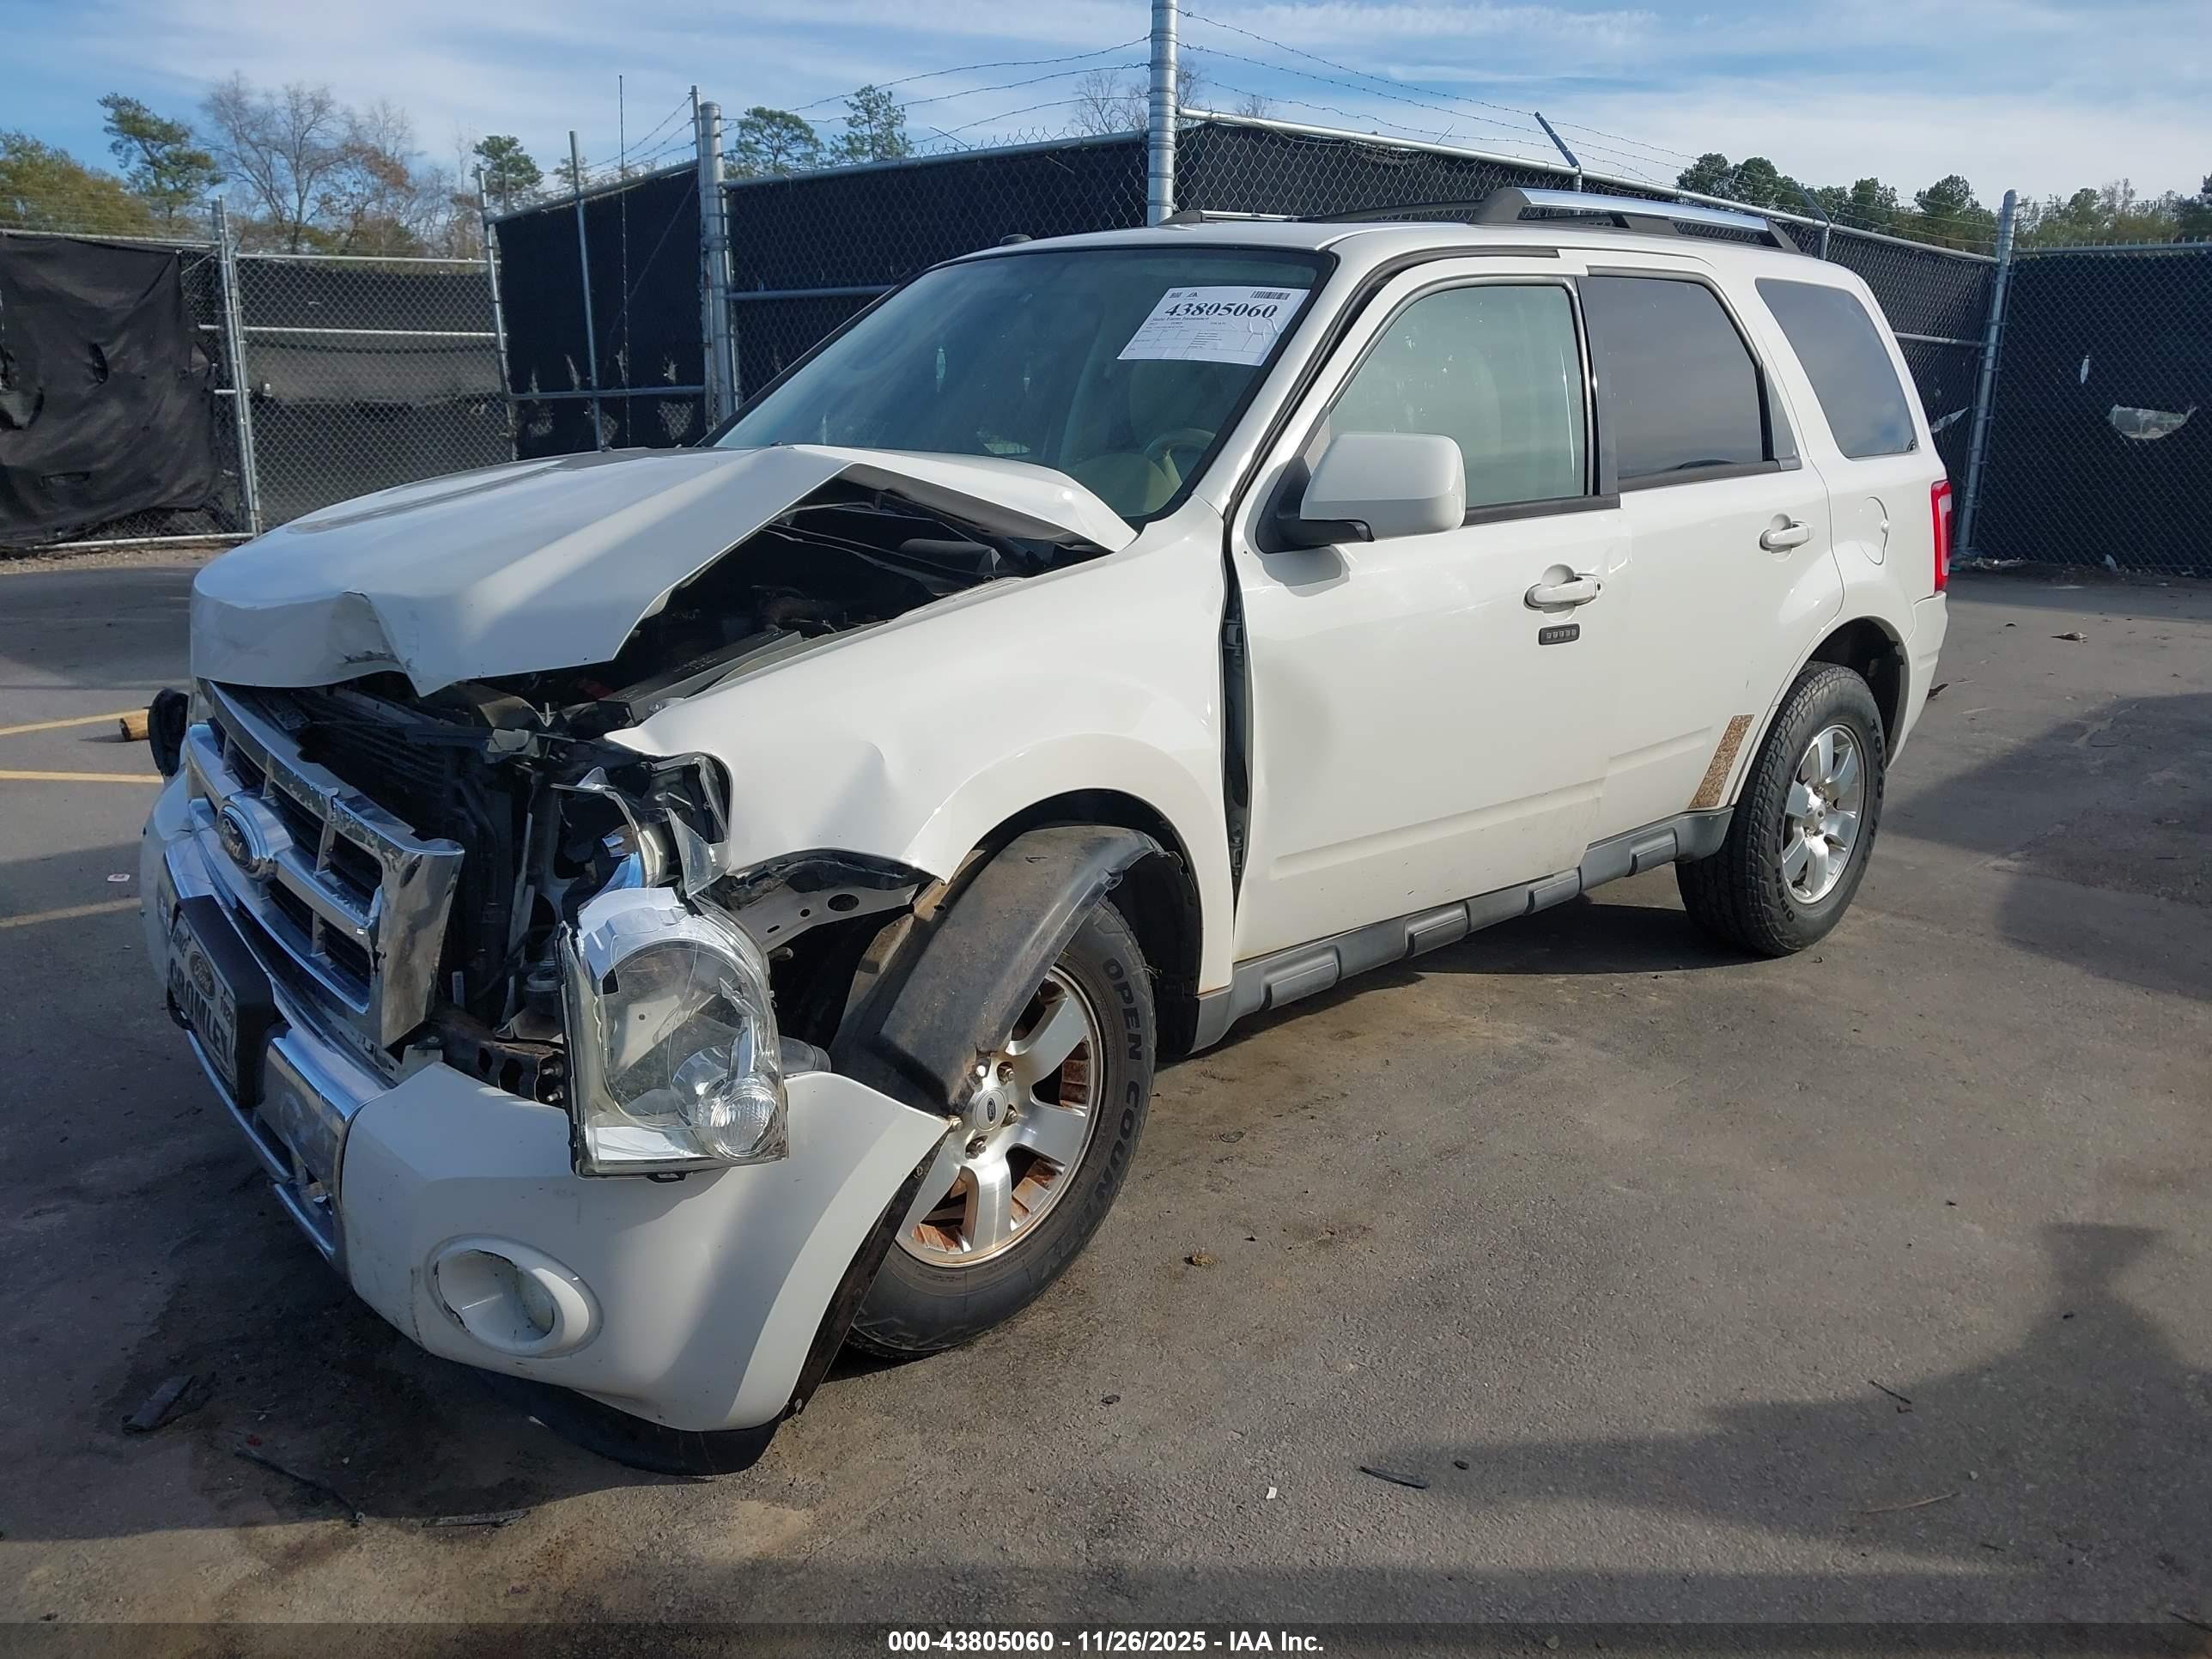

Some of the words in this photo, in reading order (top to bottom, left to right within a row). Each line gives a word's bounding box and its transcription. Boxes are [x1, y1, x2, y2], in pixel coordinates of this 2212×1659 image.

[1164, 301, 1279, 319] 43805060
[222, 817, 242, 860] Ford
[1103, 957, 1142, 1060] OPEN
